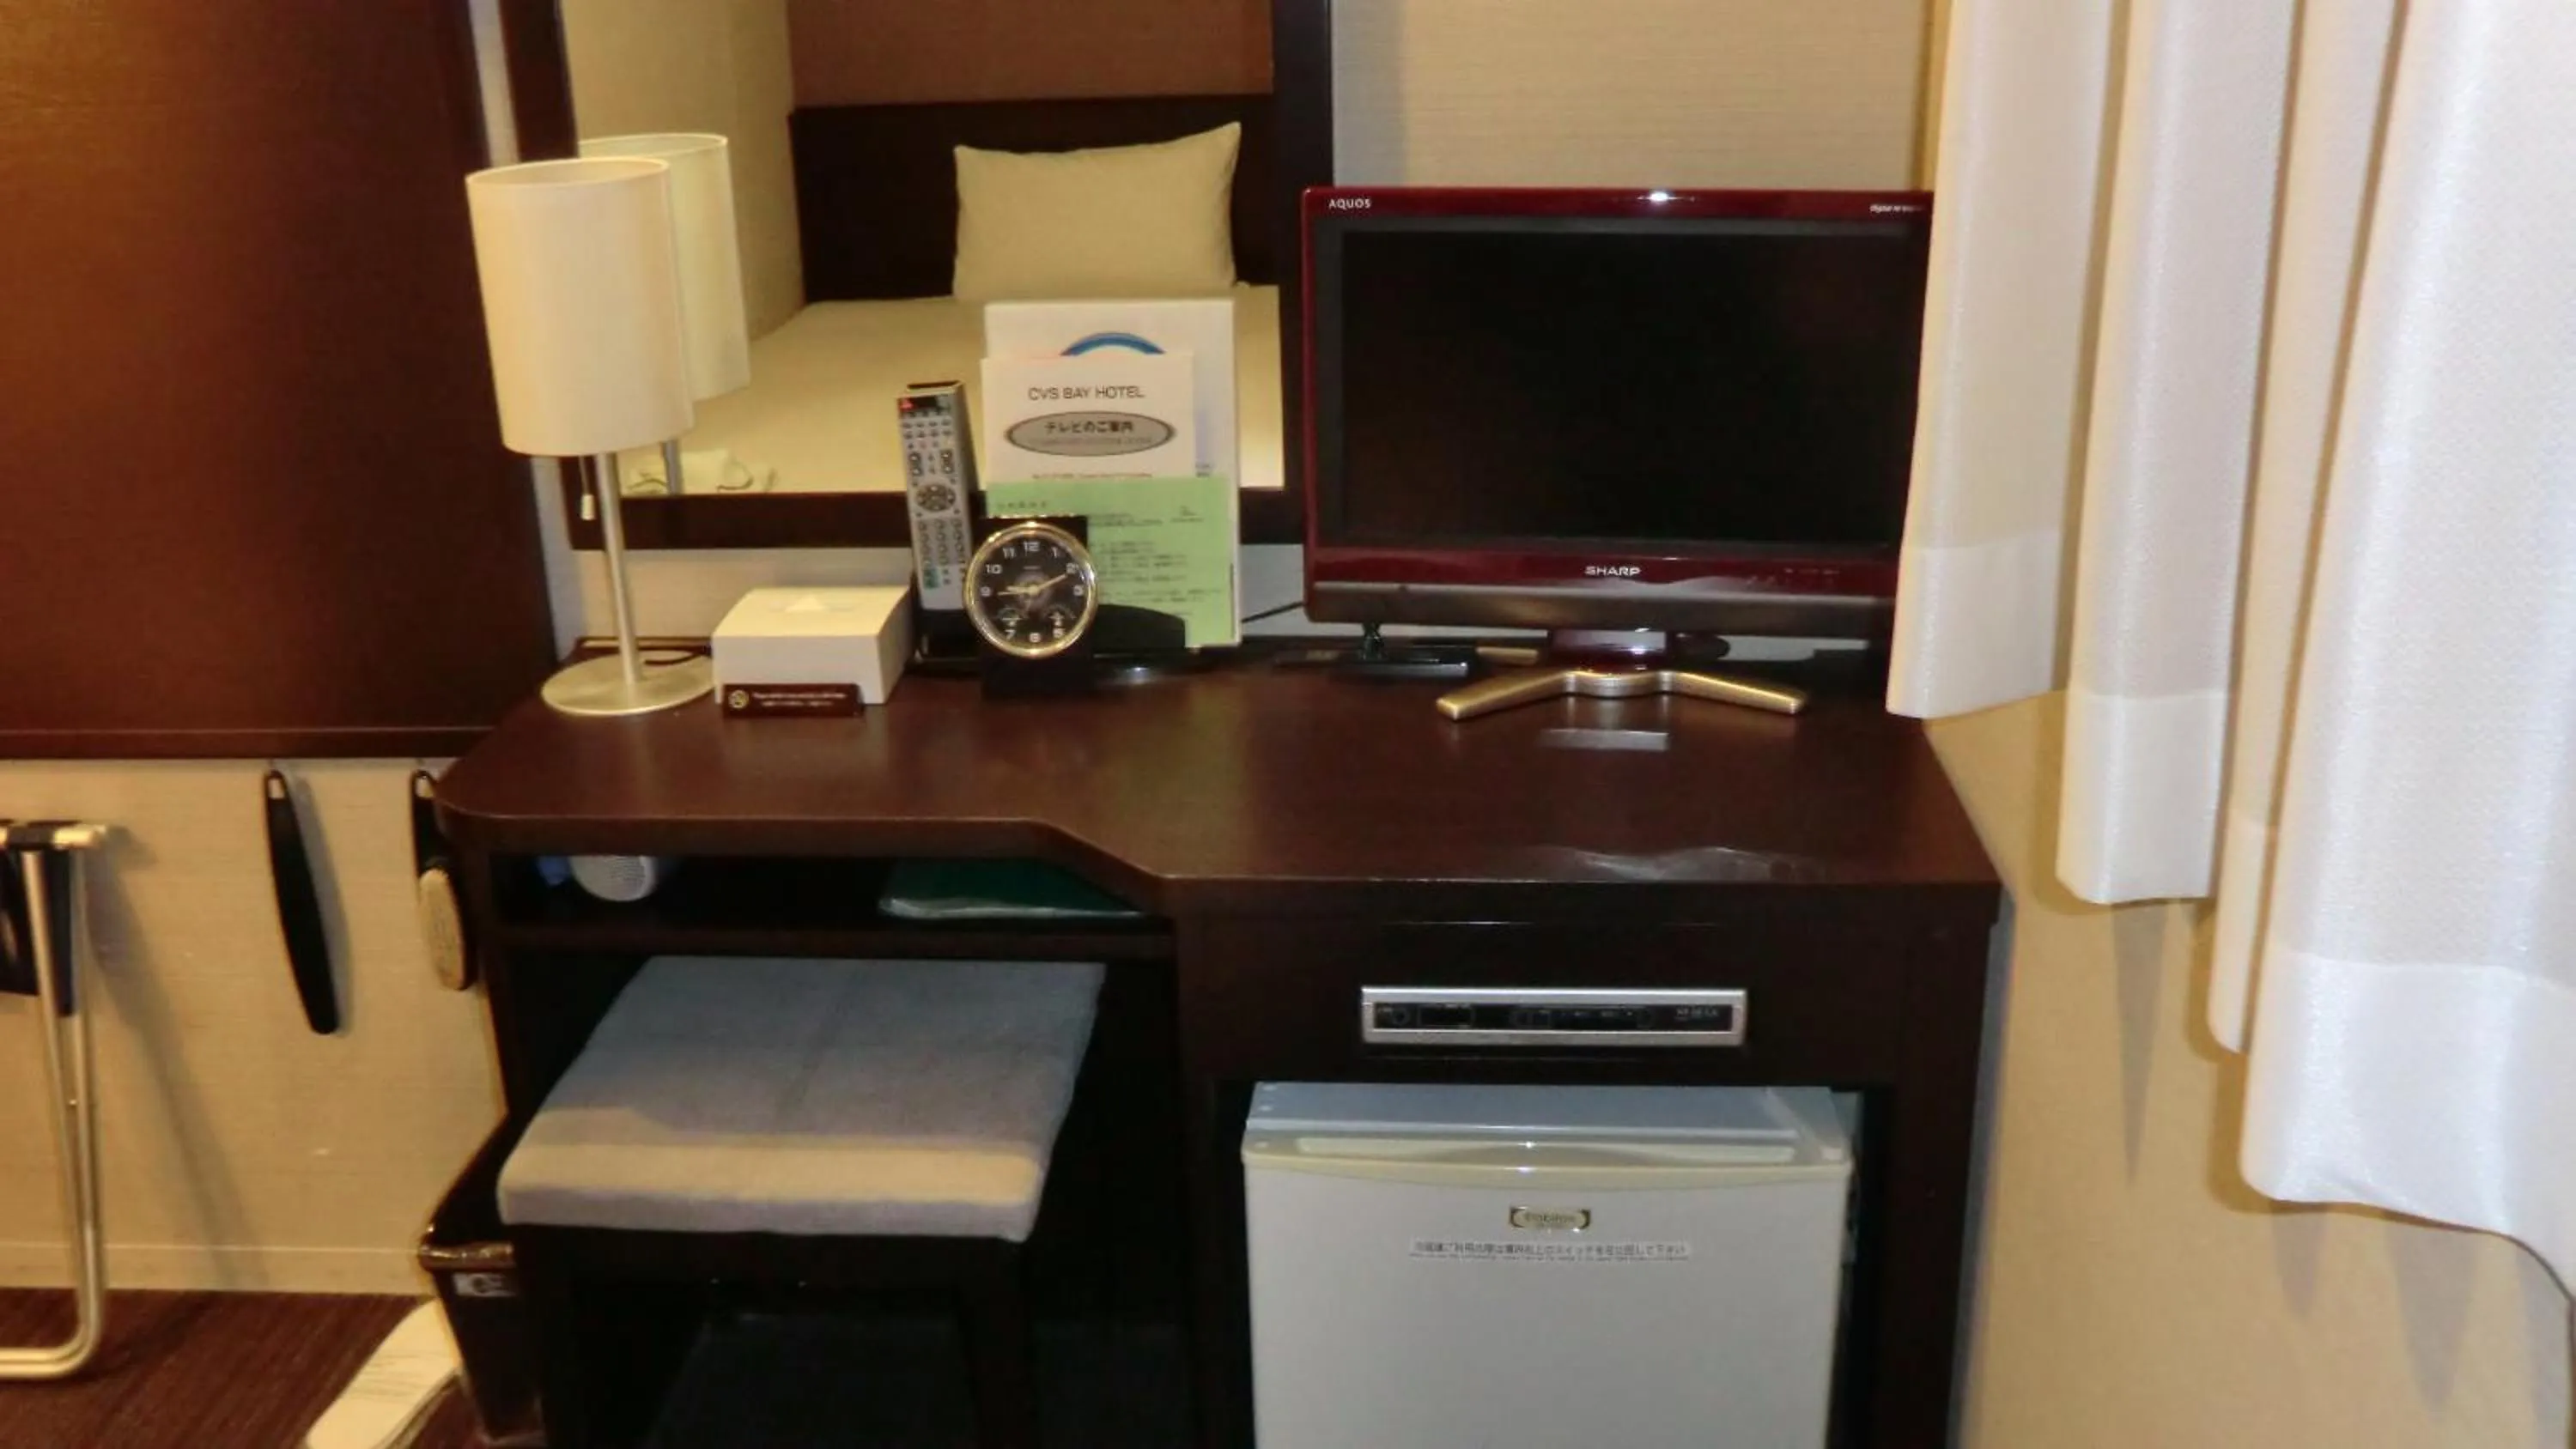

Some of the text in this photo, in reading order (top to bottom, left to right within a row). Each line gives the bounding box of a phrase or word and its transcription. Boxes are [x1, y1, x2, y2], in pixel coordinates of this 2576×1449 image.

[1328, 198, 1371, 210] AQUOS
[1028, 385, 1145, 401] CVS BAY HOTEL
[1023, 541, 1040, 552] 12
[1003, 547, 1016, 558] 11
[986, 564, 1003, 574] 10
[1584, 566, 1642, 576] SHARP
